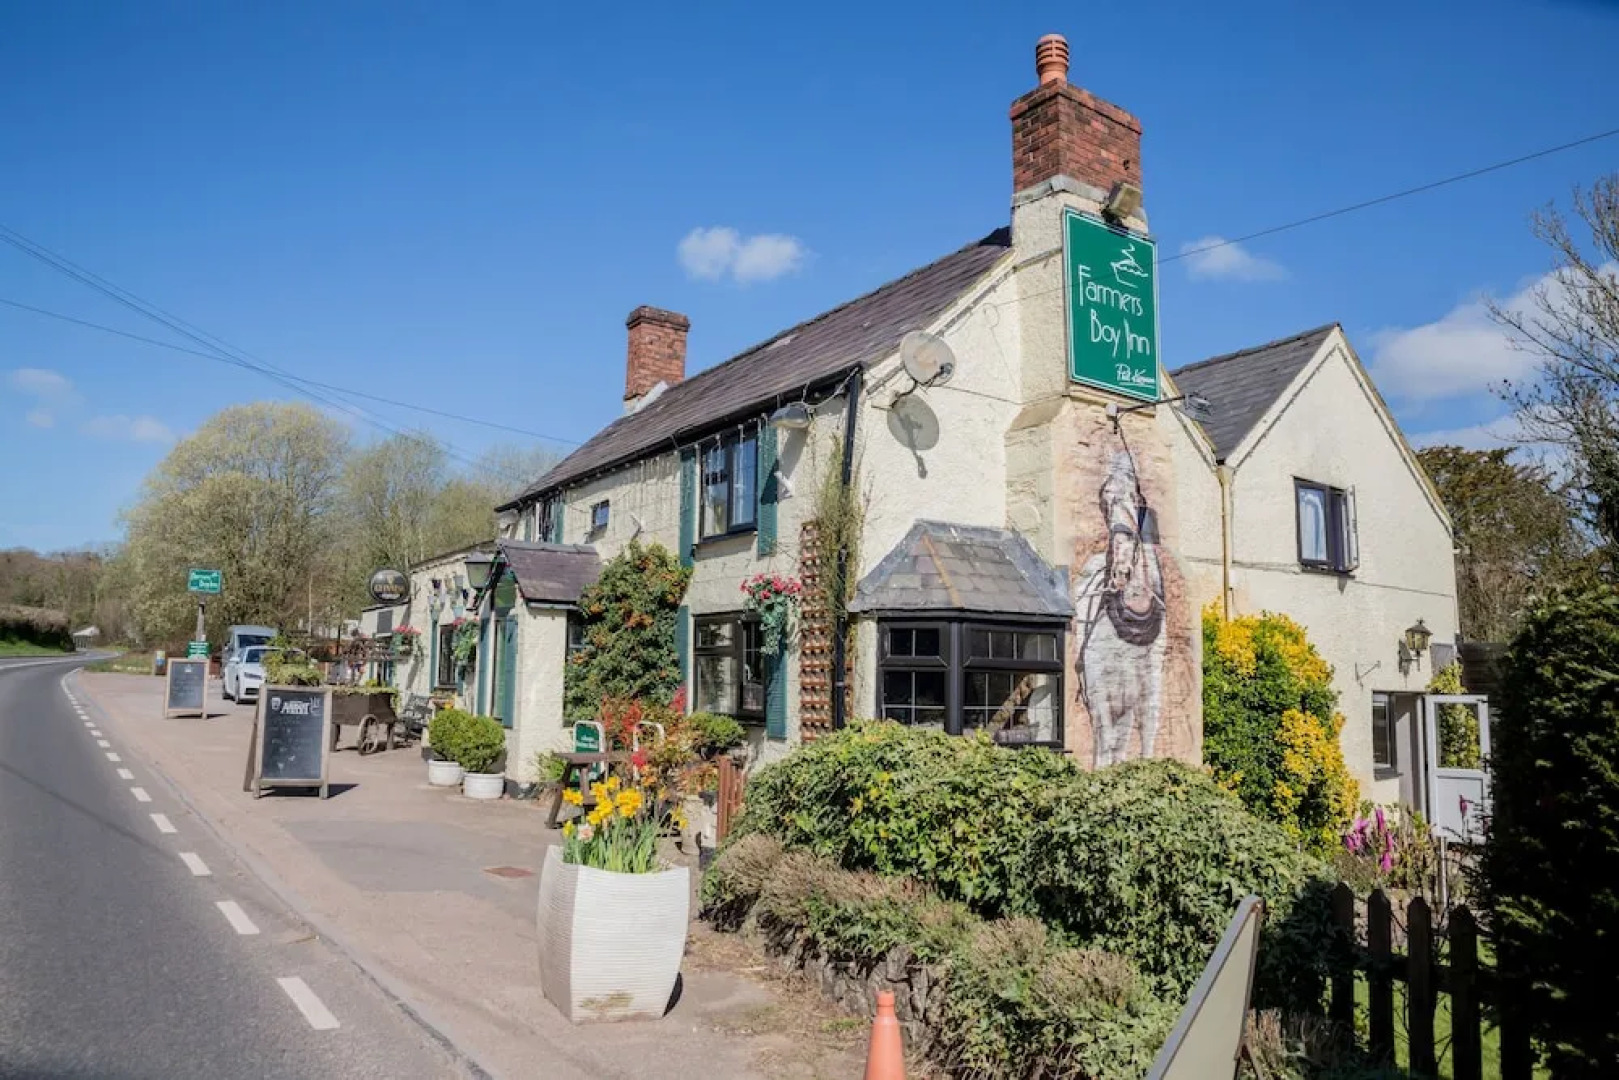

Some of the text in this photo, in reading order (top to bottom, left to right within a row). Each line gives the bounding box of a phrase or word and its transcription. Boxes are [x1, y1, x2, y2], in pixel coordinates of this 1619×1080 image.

[1078, 264, 1144, 317] Farmers
[1090, 308, 1150, 359] Boy Inn
